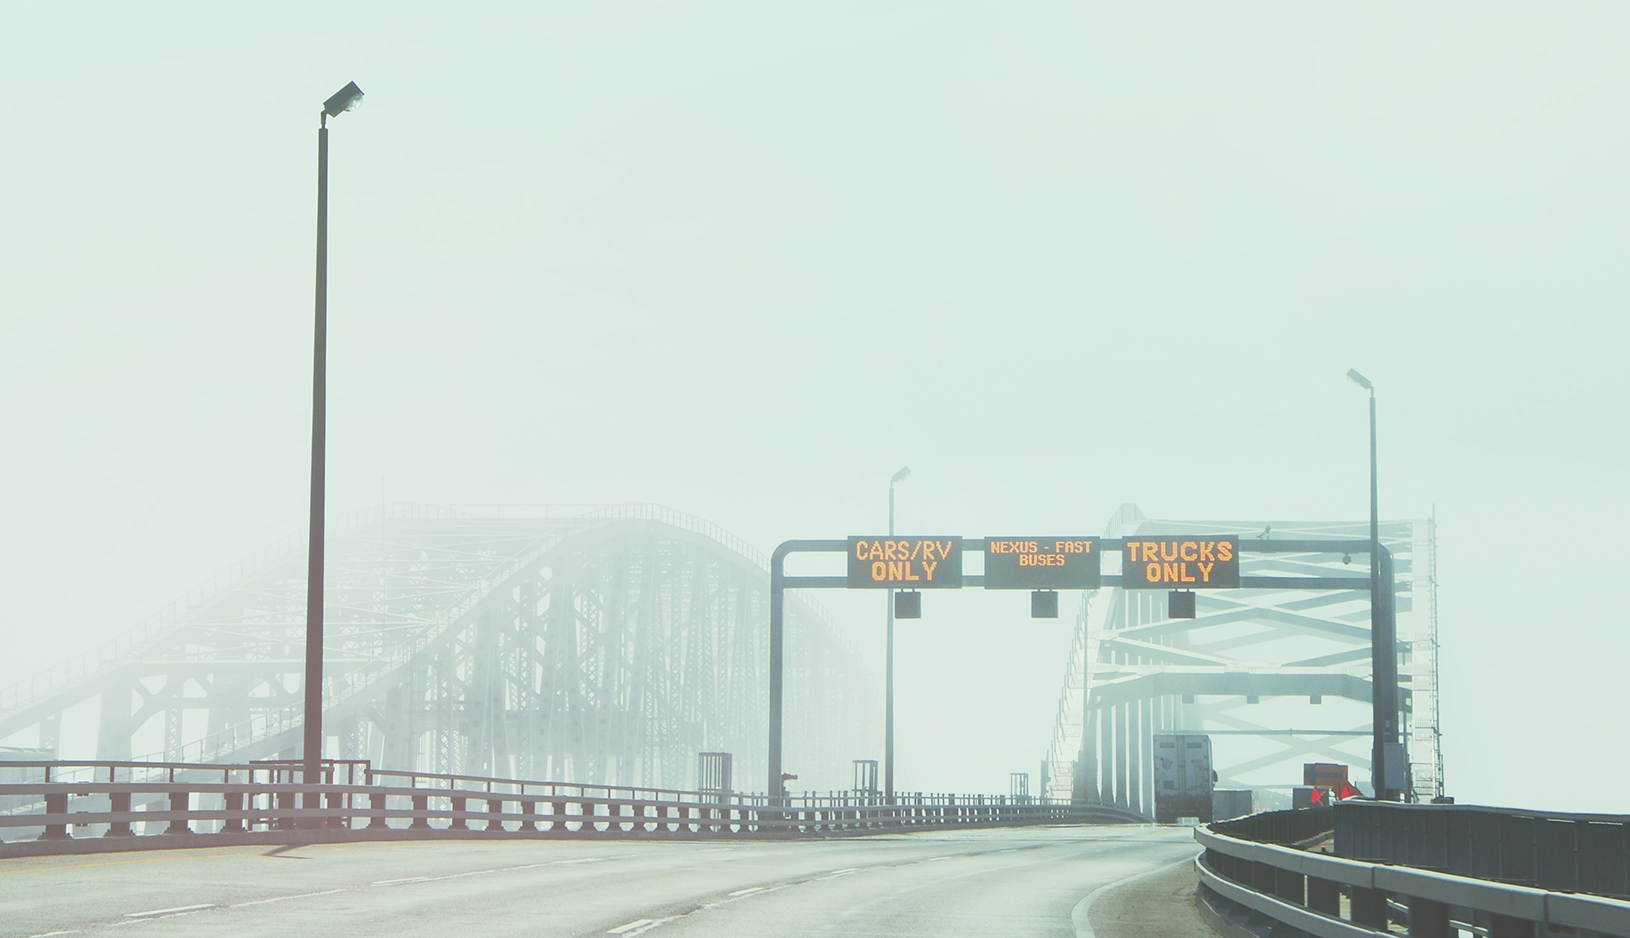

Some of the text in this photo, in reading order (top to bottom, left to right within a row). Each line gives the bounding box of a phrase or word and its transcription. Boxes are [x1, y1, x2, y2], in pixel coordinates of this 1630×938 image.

[855, 540, 952, 561] CARS/RV
[990, 541, 1038, 553] NEXUS
[1055, 541, 1092, 553] FAST
[1126, 541, 1233, 562] TRUCKS
[1018, 554, 1065, 567] BUSES
[870, 561, 938, 581] ONLY
[1145, 562, 1214, 583] ONLY
